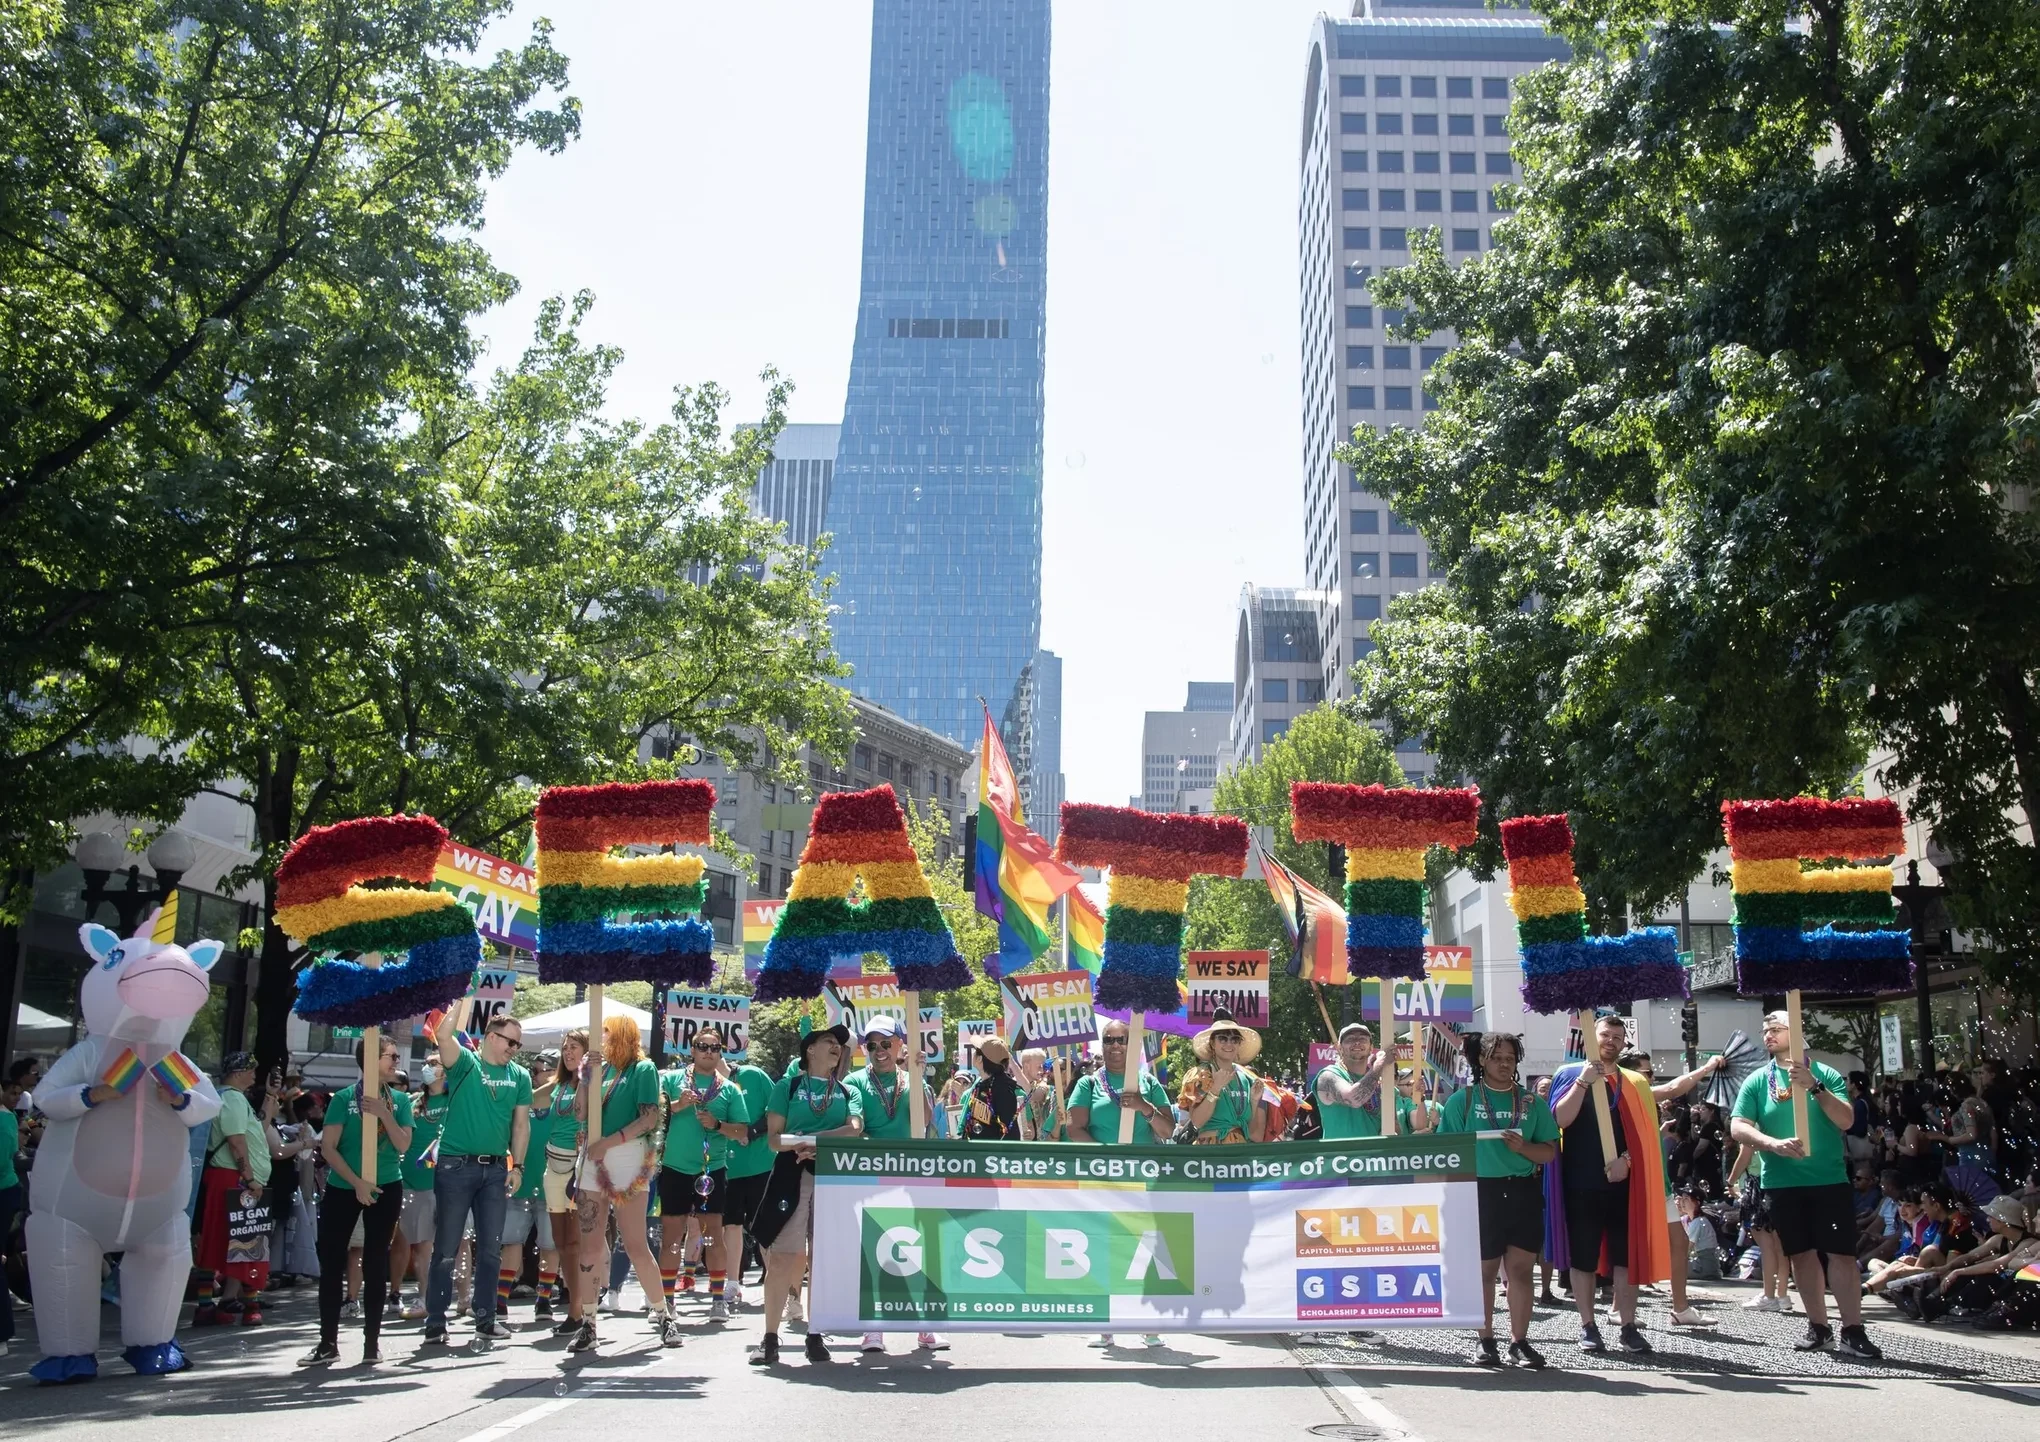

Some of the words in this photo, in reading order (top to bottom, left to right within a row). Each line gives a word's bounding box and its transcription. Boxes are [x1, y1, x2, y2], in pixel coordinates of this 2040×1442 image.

[453, 848, 493, 879] WE
[497, 866, 537, 895] SAY
[457, 883, 521, 938] GAY
[756, 906, 777, 924] W
[1196, 960, 1222, 976] WE
[1226, 960, 1260, 976] SAY
[1422, 951, 1463, 968] SAY
[480, 974, 507, 990] AY
[1016, 982, 1050, 1001] WE
[1052, 978, 1087, 998] SAY
[835, 984, 866, 1000] WE
[869, 983, 900, 999] SAY
[1393, 977, 1447, 1017] GAY
[676, 994, 704, 1010] WE
[708, 997, 741, 1013] SAY
[1193, 989, 1259, 1018] LESBIAN
[967, 1023, 994, 1036] WE
[1022, 1001, 1095, 1041] QUEER
[1885, 1022, 1895, 1033] NO
[336, 1028, 352, 1037] Pine
[1475, 1110, 1528, 1121] TOETHR
[832, 1152, 976, 1176] Washington
[984, 1156, 1067, 1175] State's
[1075, 1158, 1175, 1178] LGBTQ+
[1183, 1159, 1292, 1179] Chamber
[1299, 1156, 1325, 1176] of
[1332, 1153, 1461, 1173] Commerce
[229, 1210, 244, 1222] BE
[246, 1207, 270, 1219] GAY
[230, 1222, 272, 1237] ORGANIZE
[1303, 1213, 1431, 1238] CHBA
[875, 1225, 1178, 1280] GSBA
[1299, 1247, 1334, 1255] CAPITOL
[1356, 1245, 1395, 1253] BUSINESS
[1397, 1244, 1437, 1252] ALLIANCE
[874, 1301, 948, 1313] EQUALITY
[953, 1301, 967, 1313] IS
[973, 1302, 1016, 1313] GOOD
[1021, 1302, 1095, 1314] BUSINESS
[1301, 1308, 1359, 1317] SCHOLARSHIP
[1360, 1308, 1366, 1316] &
[1368, 1307, 1415, 1315] EDUCATION
[1417, 1306, 1440, 1314] FUND
